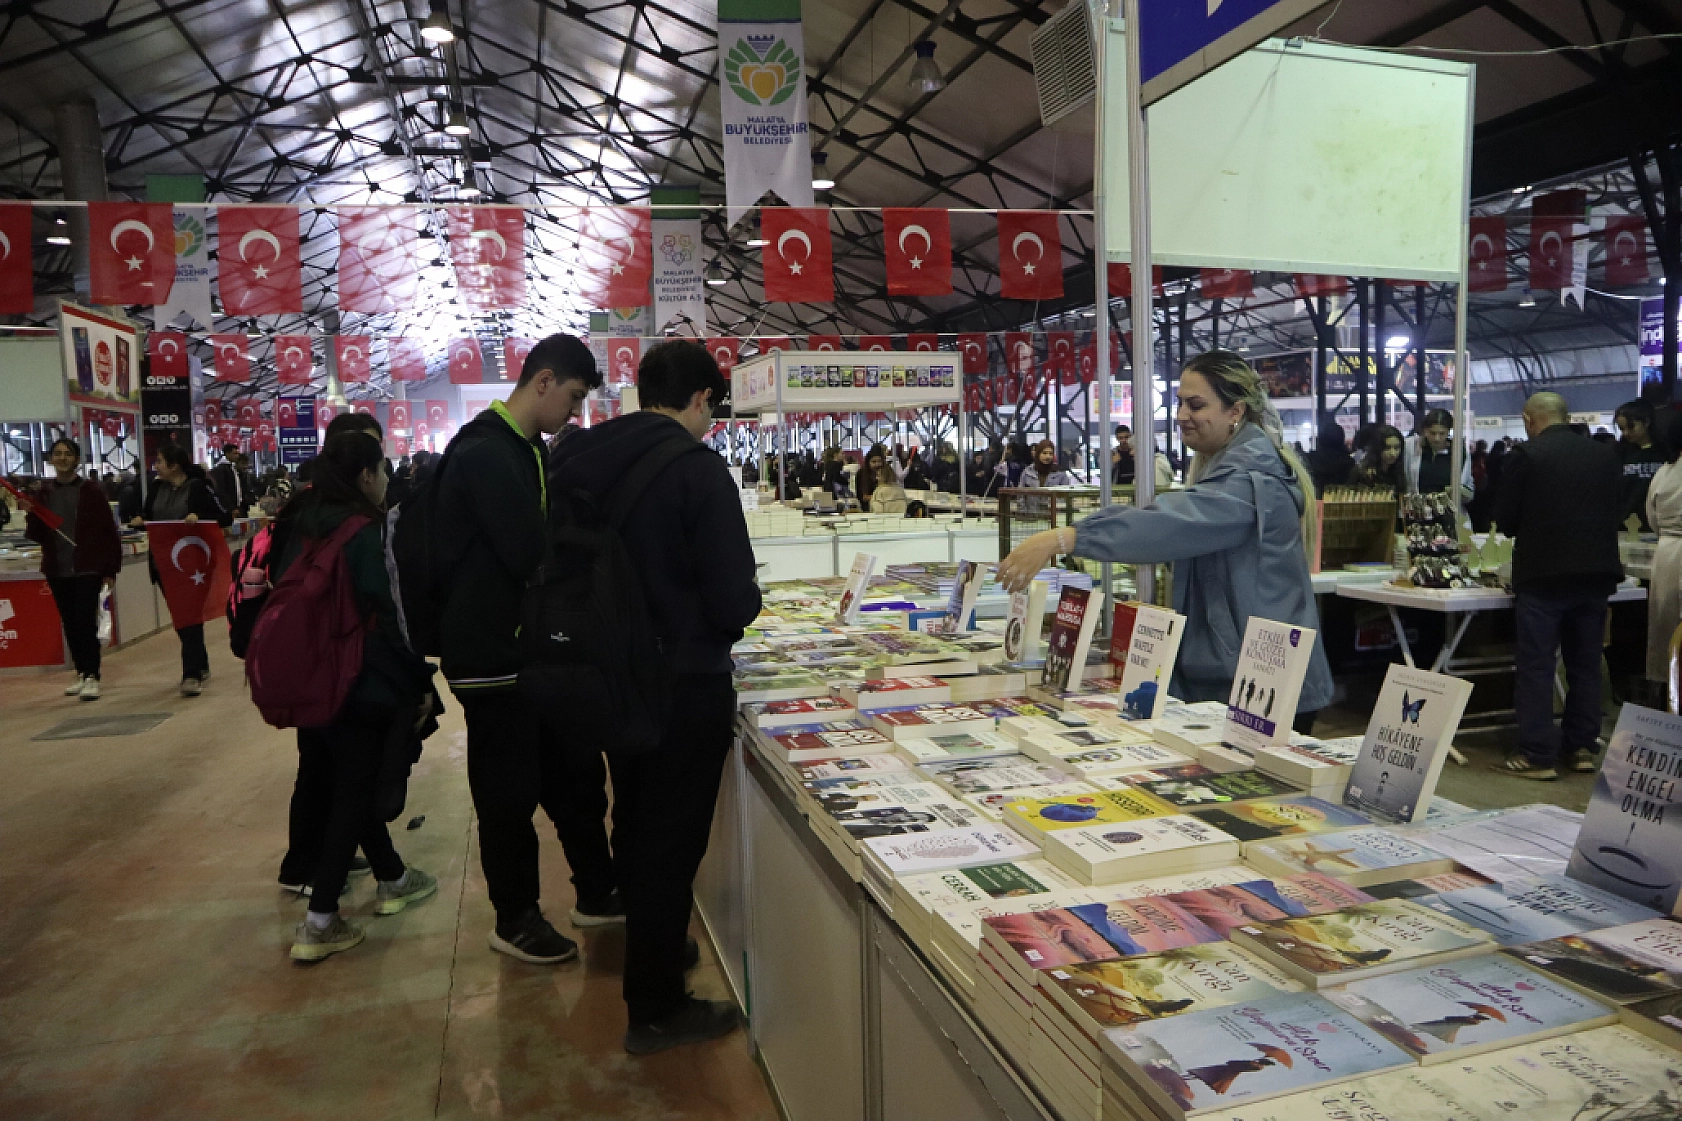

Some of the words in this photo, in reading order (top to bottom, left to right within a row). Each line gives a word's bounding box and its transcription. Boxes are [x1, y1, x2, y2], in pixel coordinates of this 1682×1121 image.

[659, 293, 687, 301] KÜLTÜR
[1371, 744, 1388, 764] HOŞ
[1388, 748, 1417, 770] GELDİN
[1626, 770, 1676, 803] ENGEL
[1621, 793, 1665, 825] OLMA
